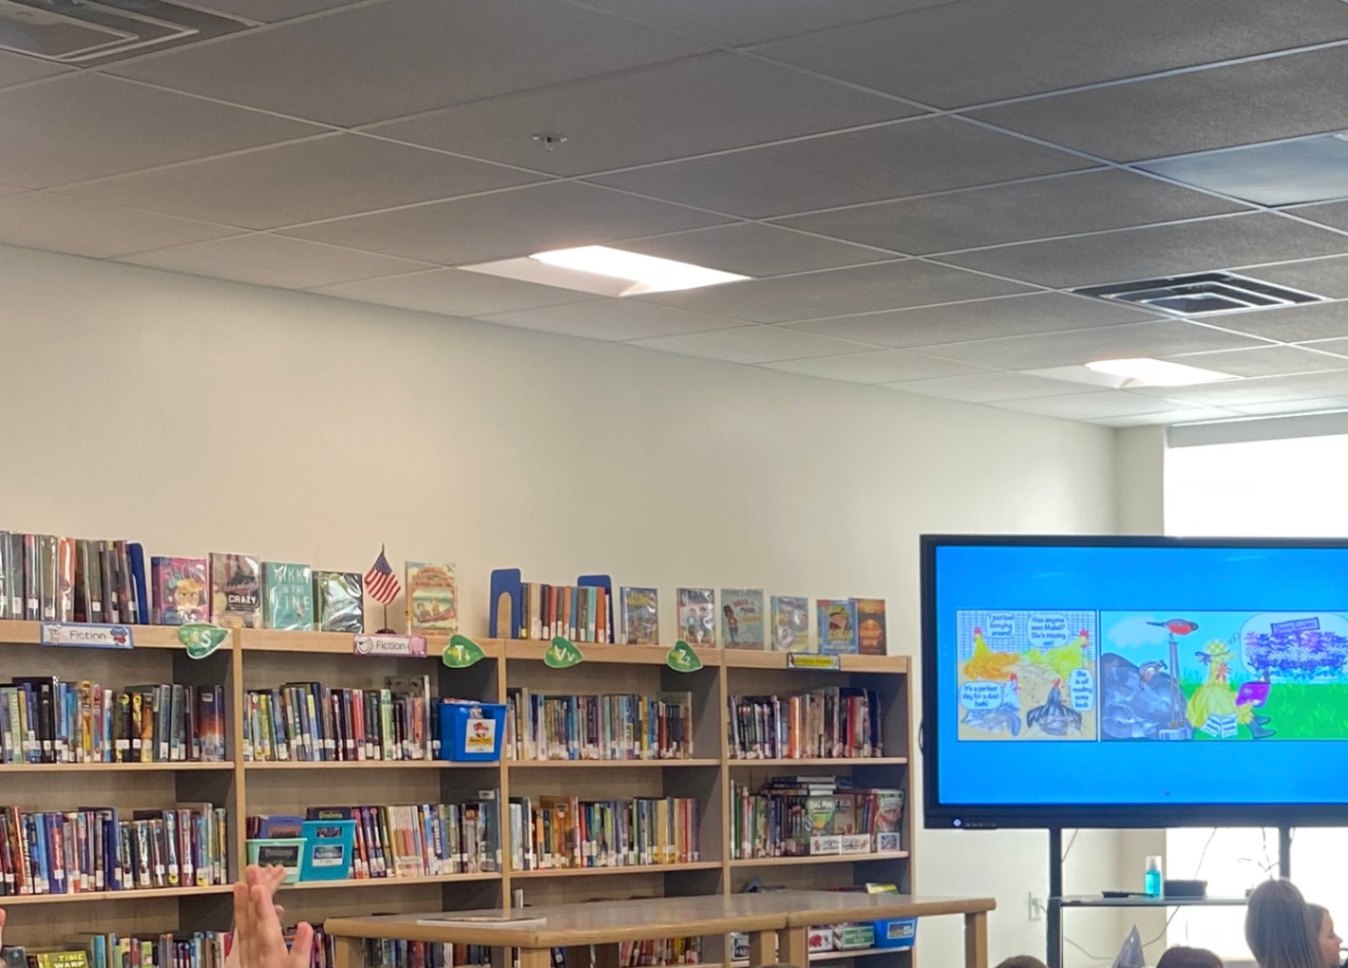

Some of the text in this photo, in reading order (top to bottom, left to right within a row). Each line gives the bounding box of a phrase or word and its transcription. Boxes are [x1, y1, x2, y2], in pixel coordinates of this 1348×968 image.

[228, 594, 257, 605] CRAZY
[69, 630, 107, 641] Fiction
[376, 640, 406, 650] Fiction
[554, 644, 575, 662] Vv
[54, 961, 85, 968] WARP
